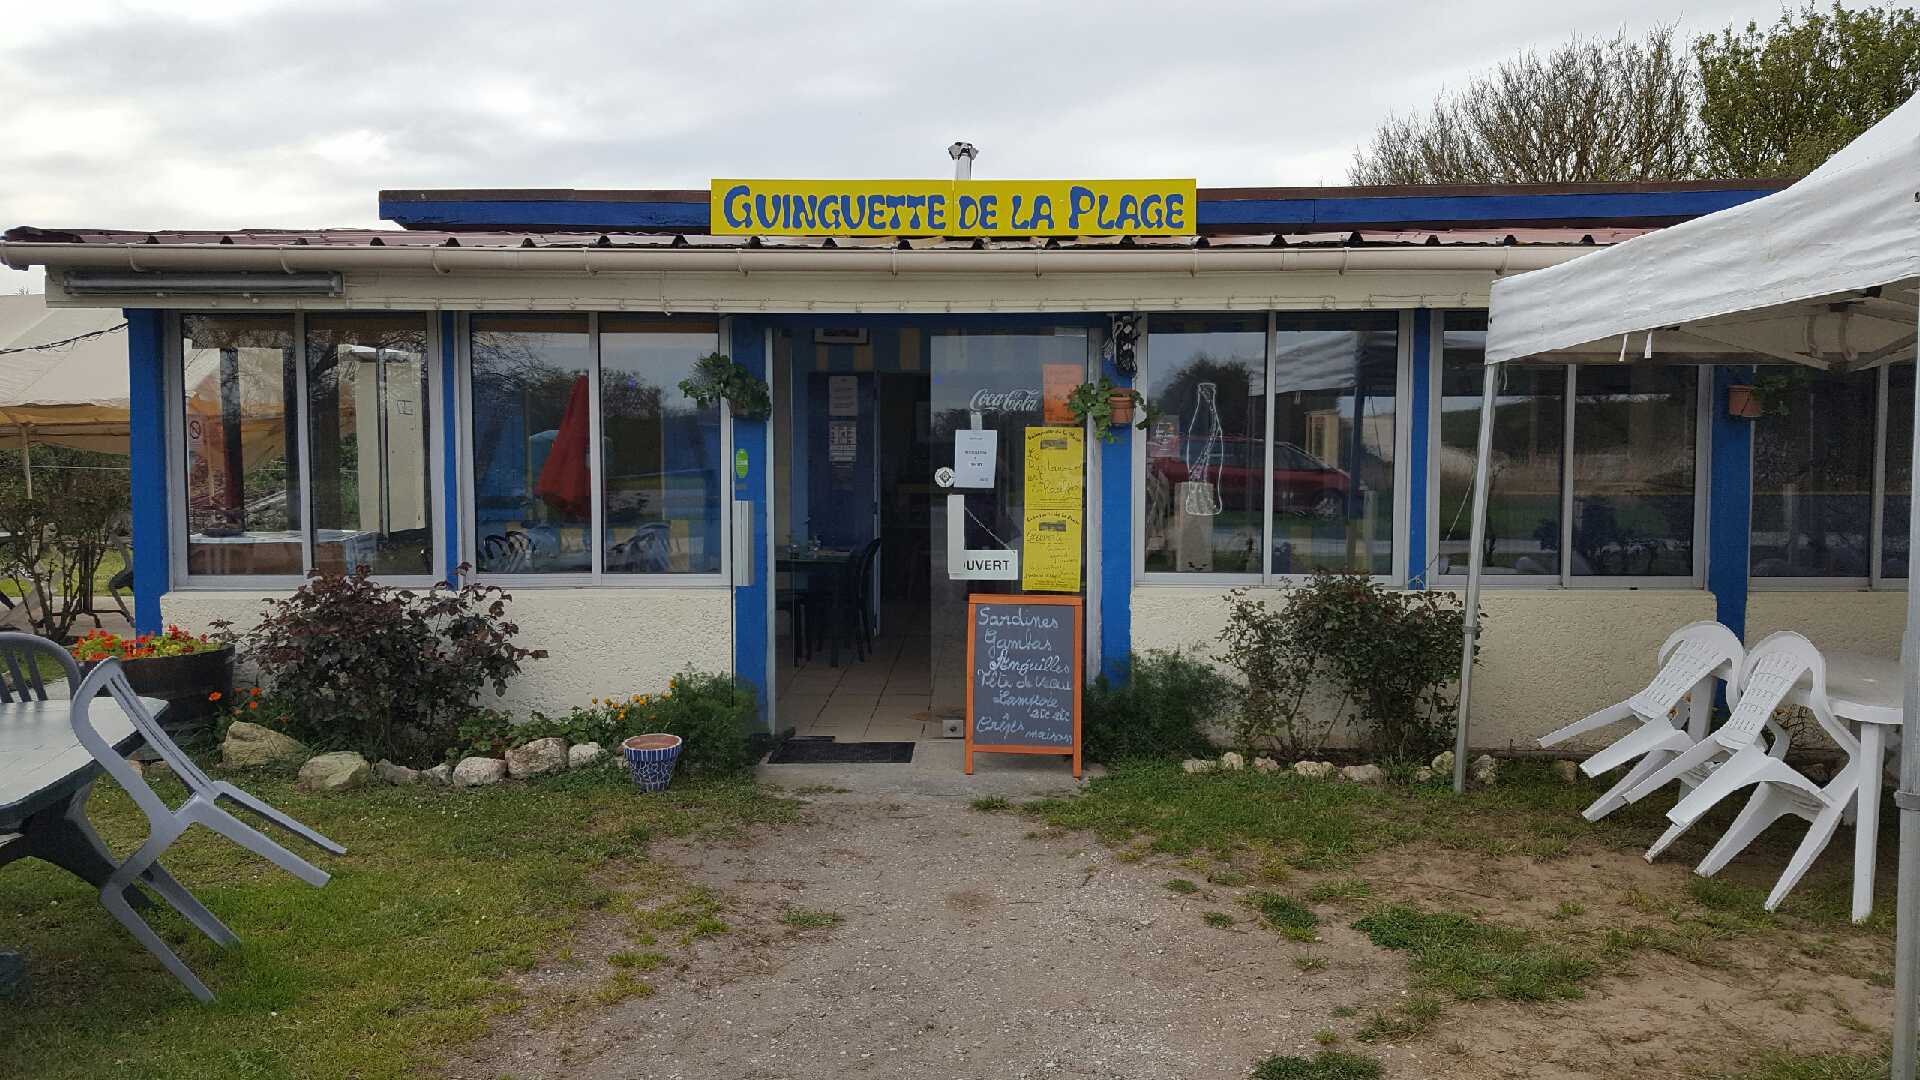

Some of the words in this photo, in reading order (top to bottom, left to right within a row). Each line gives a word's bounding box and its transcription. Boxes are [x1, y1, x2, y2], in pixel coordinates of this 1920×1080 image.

[724, 185, 945, 230] GUINGUETTE
[959, 194, 997, 229] DE
[1012, 195, 1054, 230] LA
[1068, 186, 1185, 230] PLAGE
[963, 559, 1009, 571] UVERT
[978, 607, 1059, 629] Sardines
